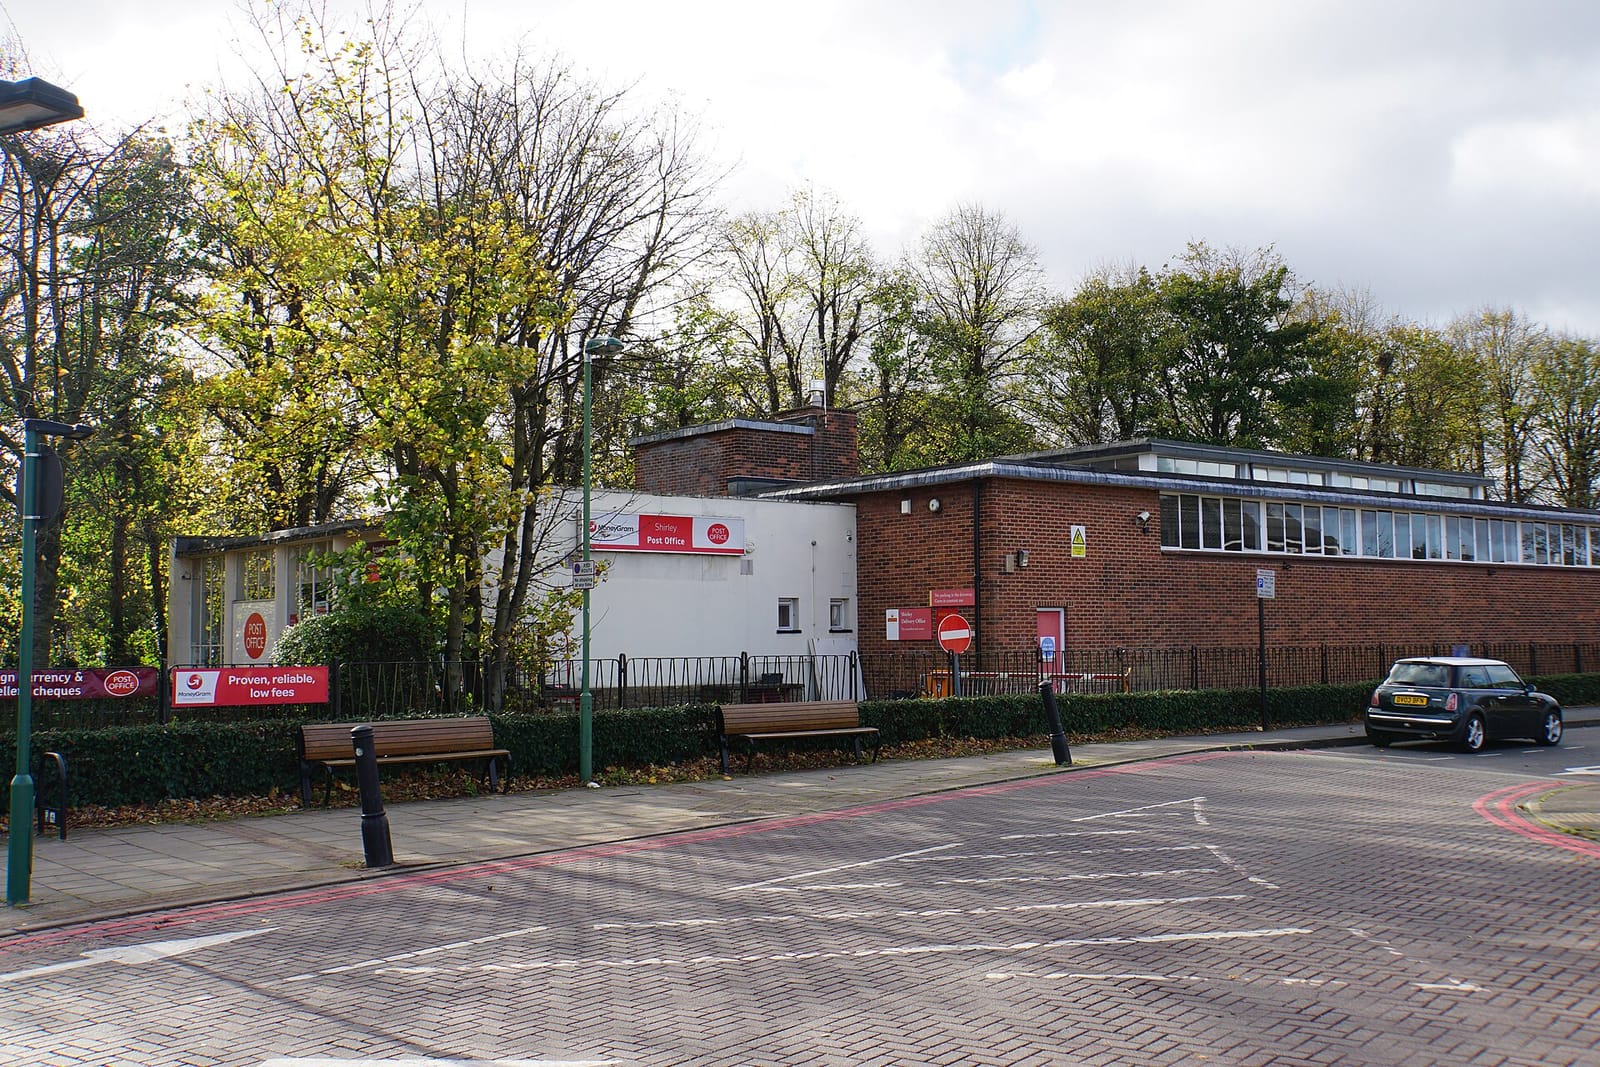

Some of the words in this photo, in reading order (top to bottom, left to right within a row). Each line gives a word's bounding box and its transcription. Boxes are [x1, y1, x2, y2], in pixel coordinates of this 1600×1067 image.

[654, 522, 678, 532] Shirley
[647, 536, 662, 545] Post
[664, 536, 685, 546] Office
[709, 533, 727, 541] OFFICE
[248, 623, 262, 635] POST
[246, 636, 264, 649] OFFICE
[30, 673, 71, 685] rrency
[74, 671, 84, 682] &
[113, 675, 133, 683] POST
[228, 675, 271, 686] Proven,
[272, 673, 316, 685] reliable,
[108, 681, 135, 690] OFFICE
[33, 685, 82, 698] cheques
[177, 690, 212, 698] MoneyGram
[250, 687, 269, 698] low
[271, 687, 295, 697] fees
